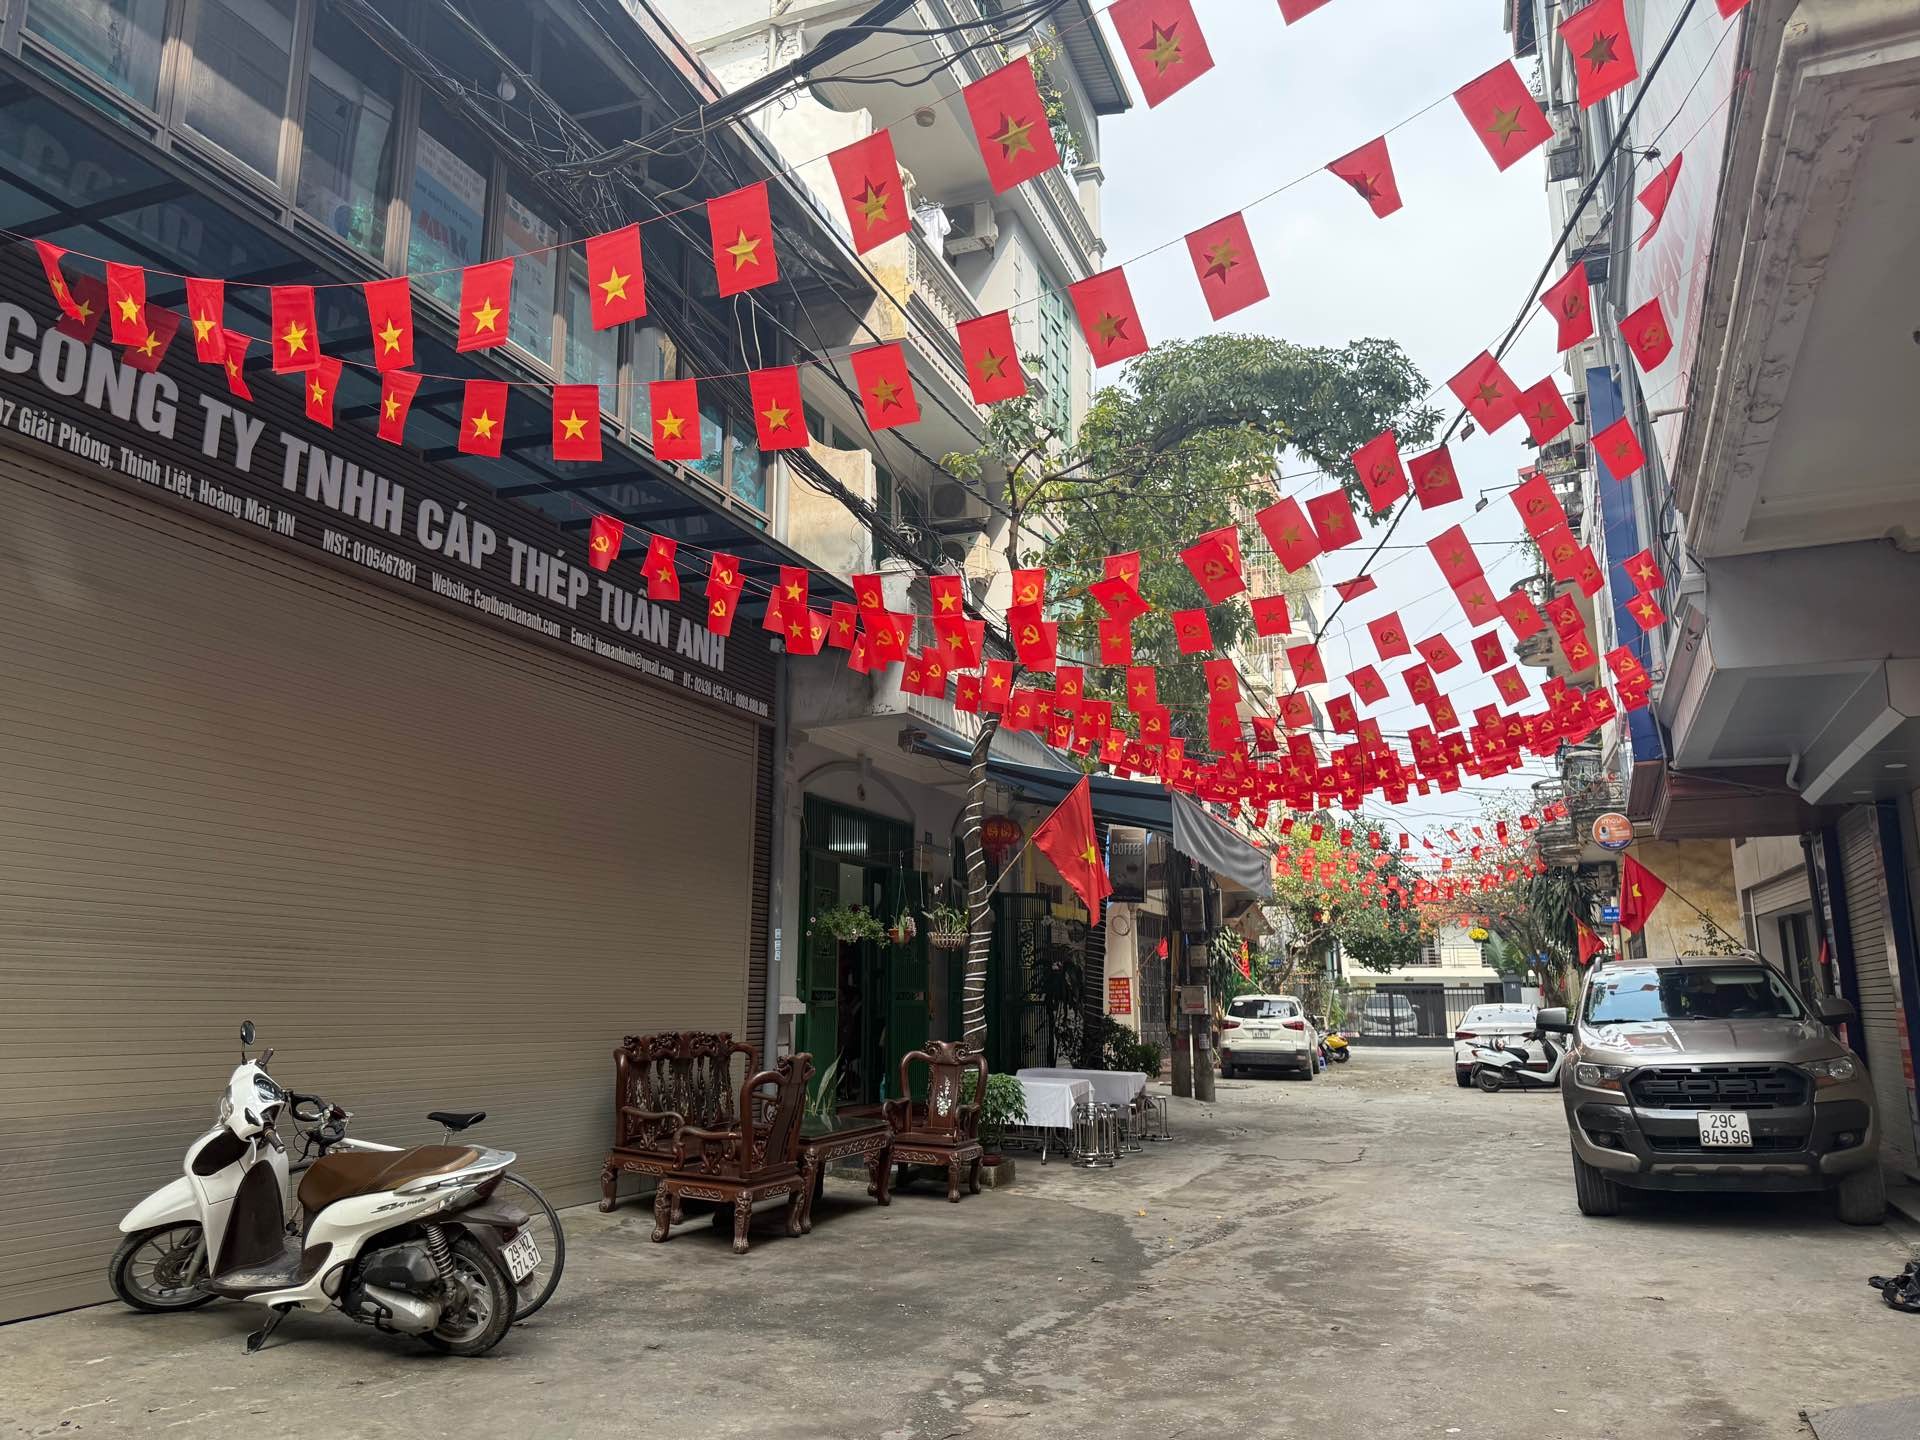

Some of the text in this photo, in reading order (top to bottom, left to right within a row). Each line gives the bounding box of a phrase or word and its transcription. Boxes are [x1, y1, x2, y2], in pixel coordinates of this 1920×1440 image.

[18, 407, 55, 443] Giải
[58, 422, 114, 470] Phóng,
[120, 446, 161, 485] Thịnh
[164, 465, 195, 501] Liệt,
[199, 479, 242, 519] Hoàng
[244, 497, 273, 532] Mai,
[276, 510, 296, 537] HN
[200, 393, 265, 473] TY
[280, 432, 405, 536] TNHH
[416, 498, 497, 569] CÁP
[507, 536, 589, 610] THÉP
[676, 617, 726, 672] ANH
[323, 529, 351, 559] MST:
[353, 541, 417, 583] 0105467881
[432, 572, 472, 605] Website:
[570, 626, 594, 651] Email:
[1702, 1130, 1750, 1145] 849.96
[1710, 1114, 1737, 1129] 29C
[508, 1234, 532, 1262] 29-H2
[512, 1247, 539, 1280] 274.97
